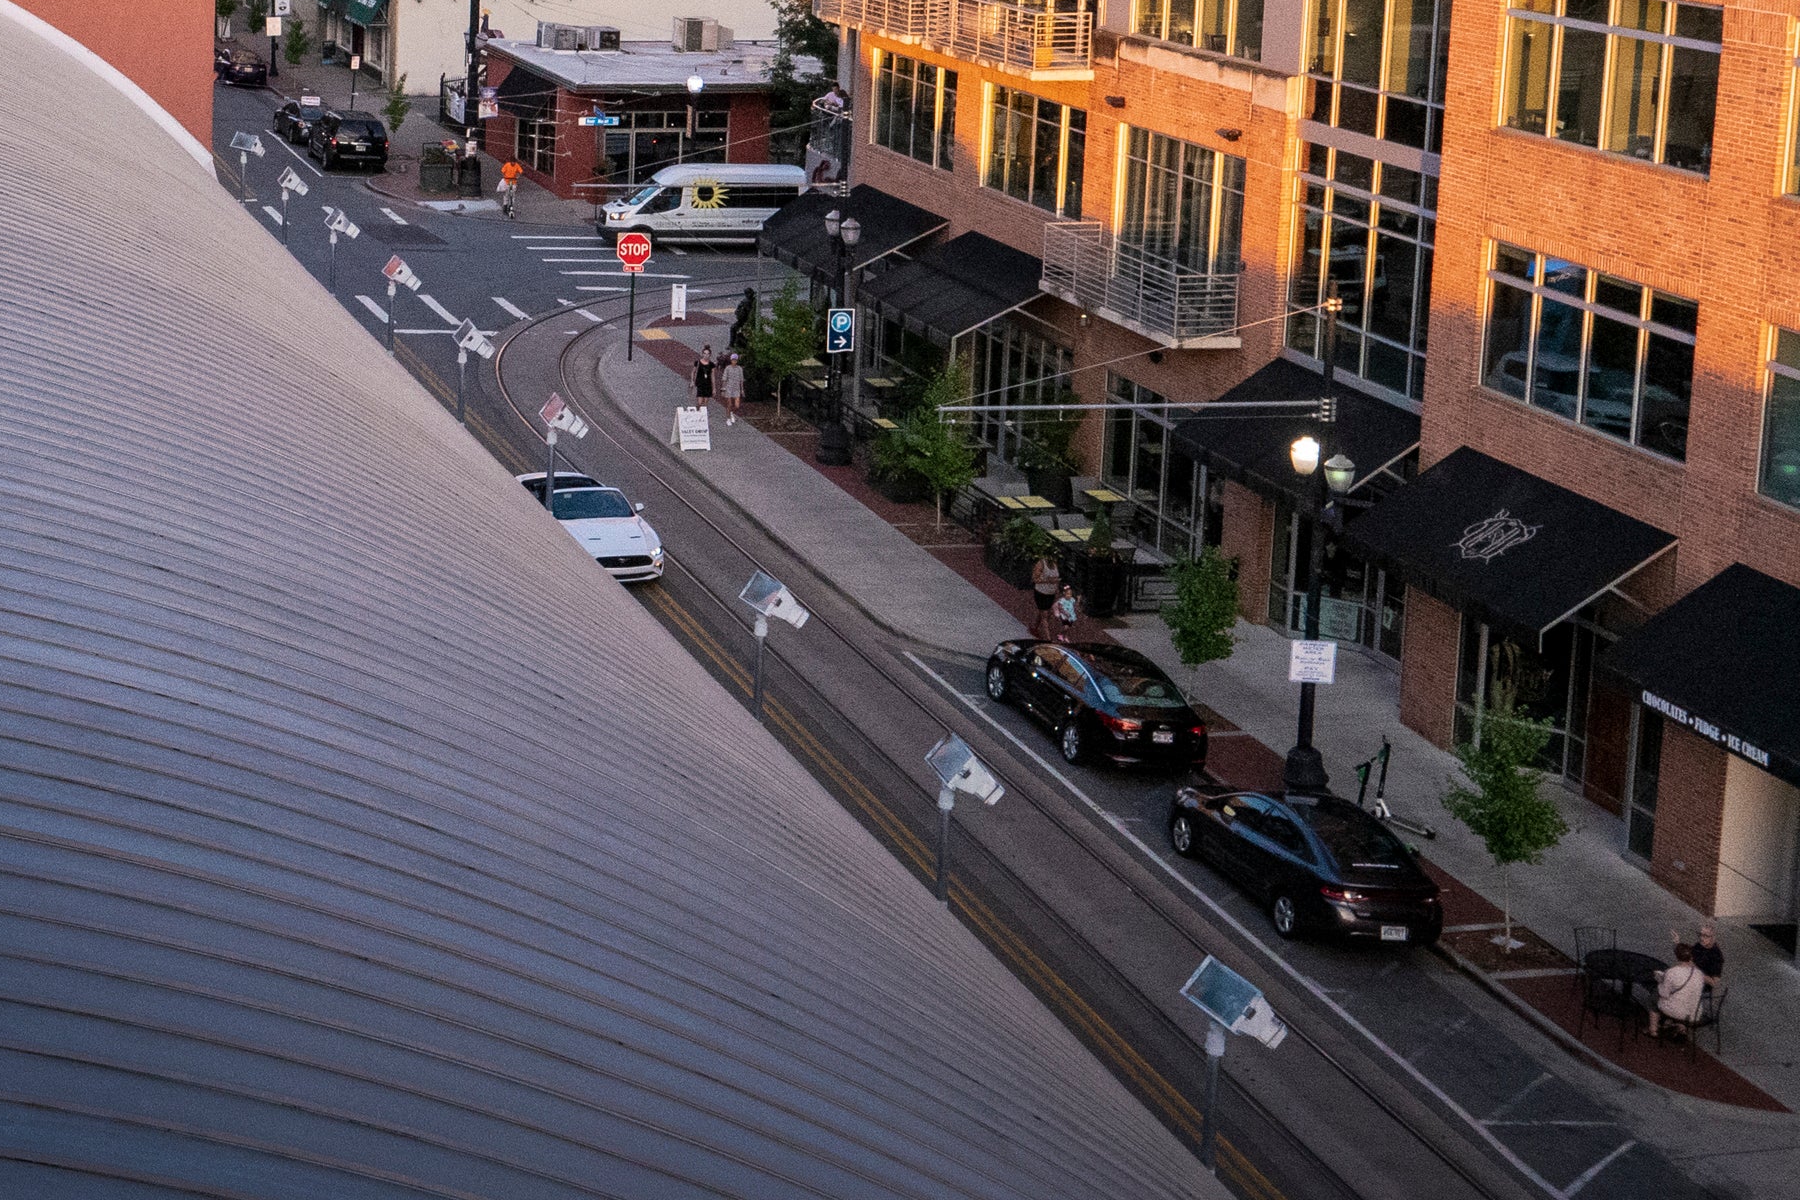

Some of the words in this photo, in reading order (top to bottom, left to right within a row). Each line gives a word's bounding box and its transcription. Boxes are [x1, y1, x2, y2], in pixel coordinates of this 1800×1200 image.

[619, 242, 649, 256] STOP
[836, 315, 848, 330] P
[1641, 689, 1688, 724] CHOCOLATES
[1693, 716, 1721, 741] FUDGE
[1727, 732, 1742, 752] ICE
[1741, 741, 1770, 768] CREAM
